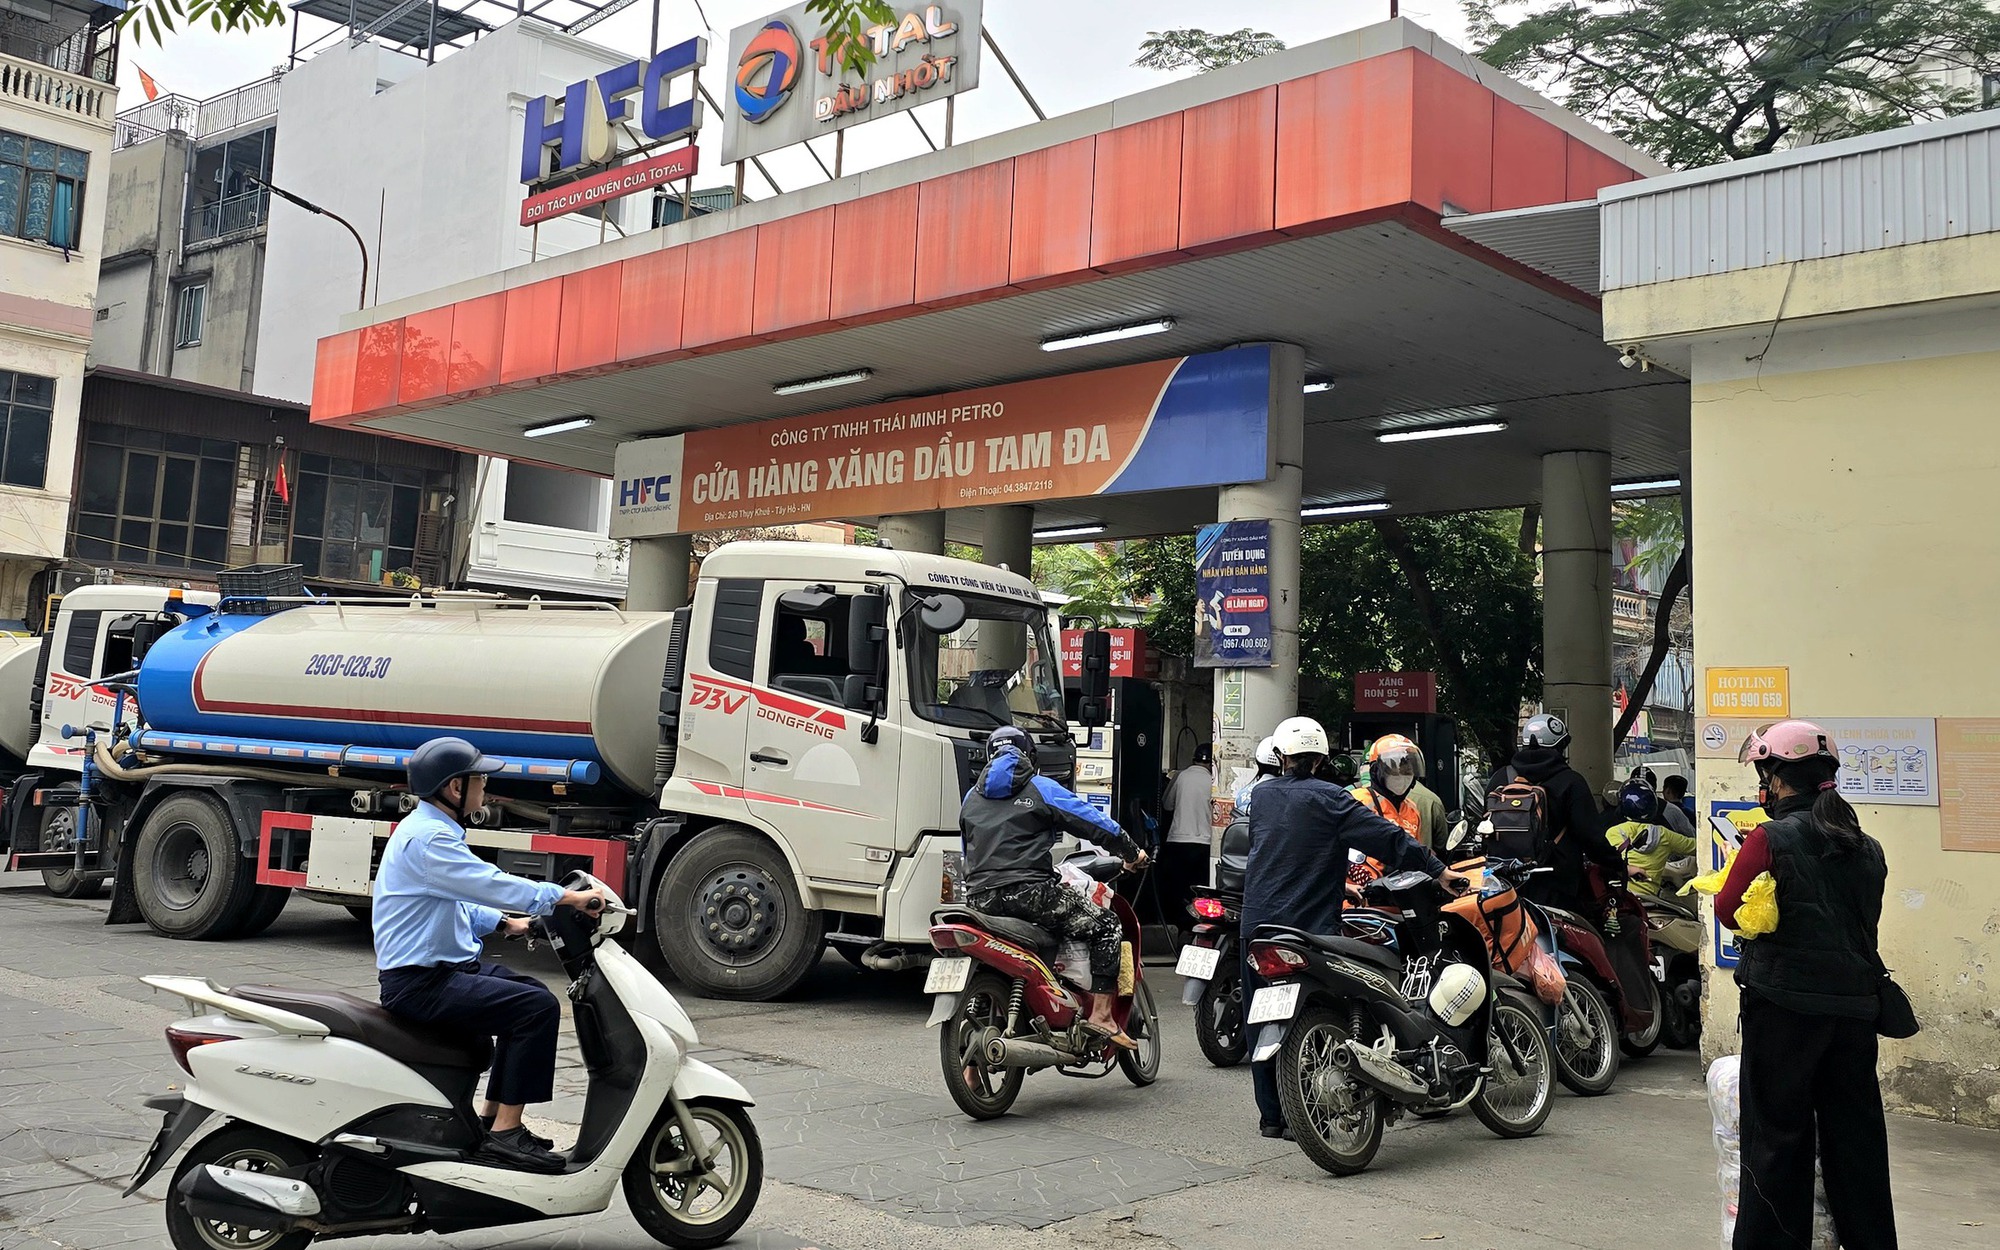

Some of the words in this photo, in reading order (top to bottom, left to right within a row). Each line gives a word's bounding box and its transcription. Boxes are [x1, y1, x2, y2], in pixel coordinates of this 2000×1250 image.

[521, 36, 707, 186] HFC
[527, 203, 545, 218] ĐỐI
[547, 196, 567, 212] TÁC
[585, 177, 621, 201] QUYỀN
[623, 171, 647, 189] CỦA
[770, 427, 808, 448] CÔNG
[811, 426, 829, 442] TY
[832, 421, 869, 439] TNHH
[873, 412, 906, 434] THÁI
[910, 410, 946, 429] MINH
[951, 401, 1005, 423] PETRO
[692, 460, 740, 505] CỬA
[747, 458, 819, 499] HÀNG
[826, 448, 904, 490] XĂNG
[913, 430, 976, 482] DẦU
[984, 430, 1052, 474] TAM
[1062, 424, 1111, 466] ĐA
[620, 474, 671, 506] HFC
[960, 487, 977, 499] Điện
[979, 485, 1001, 497] Thoại:
[1003, 480, 1053, 493] 04.3847.2118
[704, 512, 714, 523] Địa
[728, 510, 738, 519] 249
[775, 506, 786, 516] Tây
[787, 503, 796, 513] Hồ
[801, 503, 811, 512] HN
[1245, 548, 1266, 562] DỤNG
[1202, 566, 1219, 578] NHÂN
[1220, 565, 1234, 577] VIÊN
[1235, 564, 1249, 576] BÁN
[1249, 563, 1268, 575] HÀNG
[928, 571, 950, 584] CÔNG
[950, 576, 959, 585] TY
[960, 575, 979, 589] CÔNG
[979, 579, 995, 592] VIÊN
[995, 582, 1008, 594] CÂY
[1233, 598, 1247, 608] LÀM
[1248, 598, 1265, 608] NGAY
[1222, 637, 1268, 649] 0967.400.602
[1112, 650, 1131, 661] 95-III
[304, 653, 392, 679] 29CD-028.30
[49, 679, 87, 701] D3V
[1378, 676, 1404, 687] XĂNG
[1718, 676, 1776, 689] HOTLINE
[689, 683, 750, 715] D3V
[1364, 688, 1384, 698] RON
[1386, 688, 1399, 698] 95
[1408, 688, 1419, 698] III
[1712, 692, 1738, 707] 0915
[1740, 692, 1760, 707] 990
[1762, 692, 1783, 707] 658
[91, 694, 139, 714] DONGENG
[756, 706, 835, 740] DONGFENG
[1735, 820, 1755, 828] Chào
